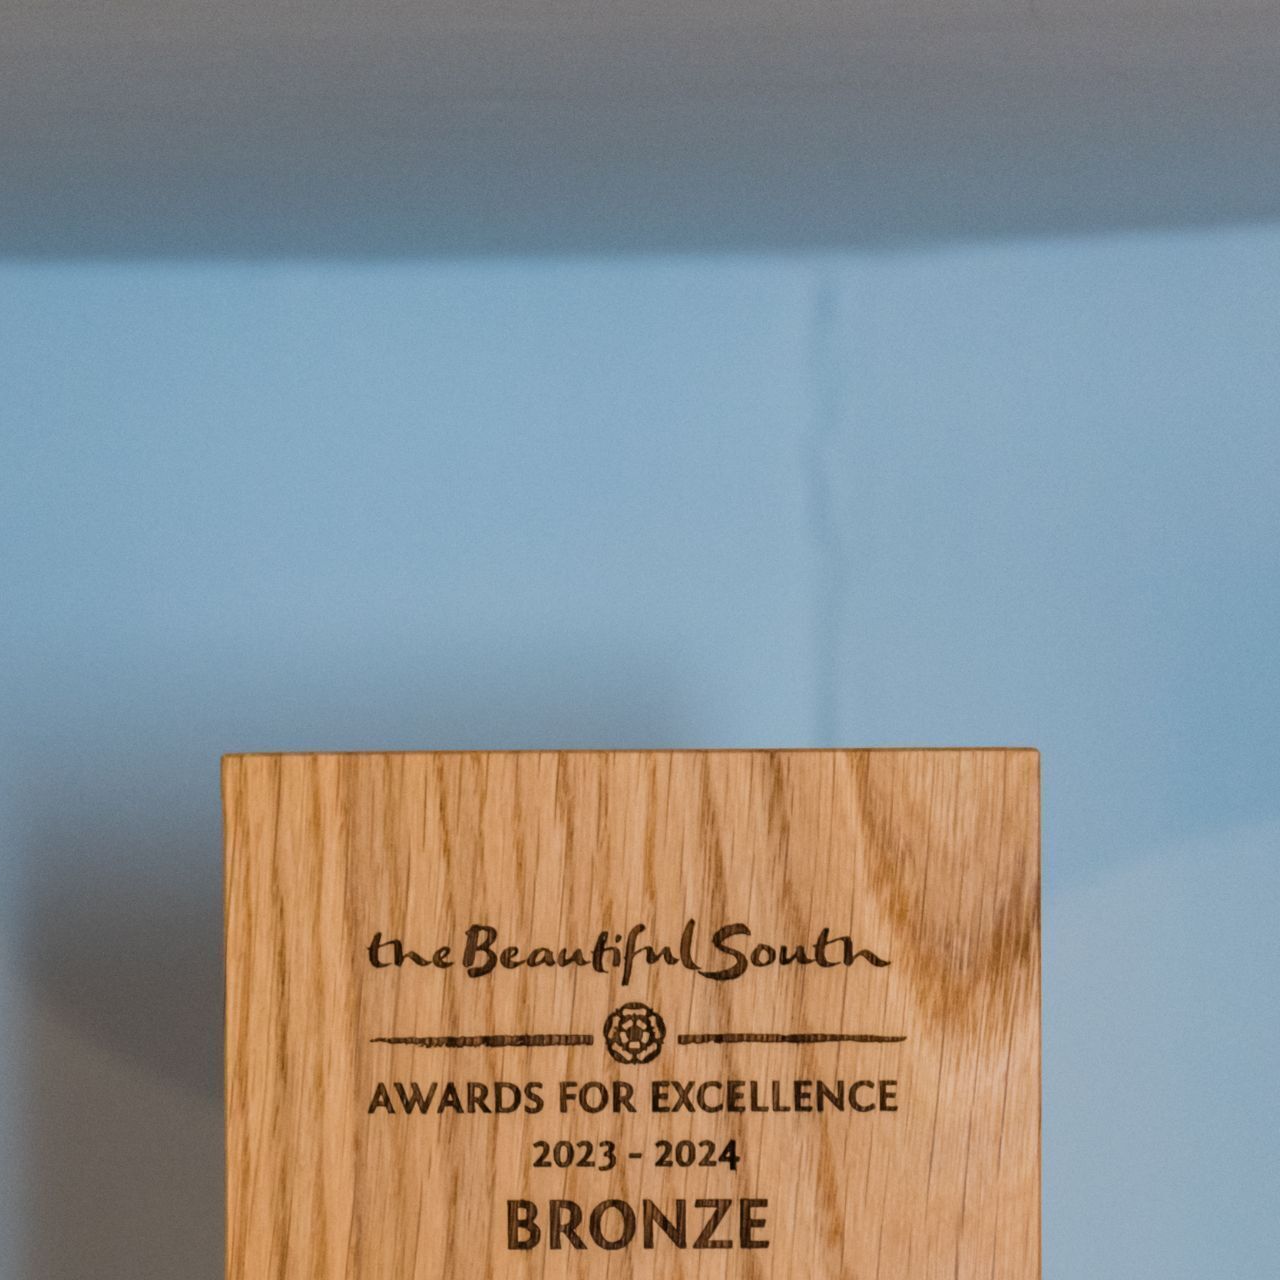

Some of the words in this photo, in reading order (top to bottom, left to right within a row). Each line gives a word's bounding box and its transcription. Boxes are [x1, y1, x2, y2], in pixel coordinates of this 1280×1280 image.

[367, 929, 454, 969] the
[463, 919, 700, 985] Beautiful
[699, 923, 891, 981] South
[368, 1081, 544, 1115] AWARDS
[560, 1081, 637, 1114] FOR
[652, 1079, 899, 1113] EXCELLENCE
[533, 1140, 616, 1171] 2023
[655, 1139, 741, 1171] 2024
[506, 1198, 771, 1250] BRONZE
